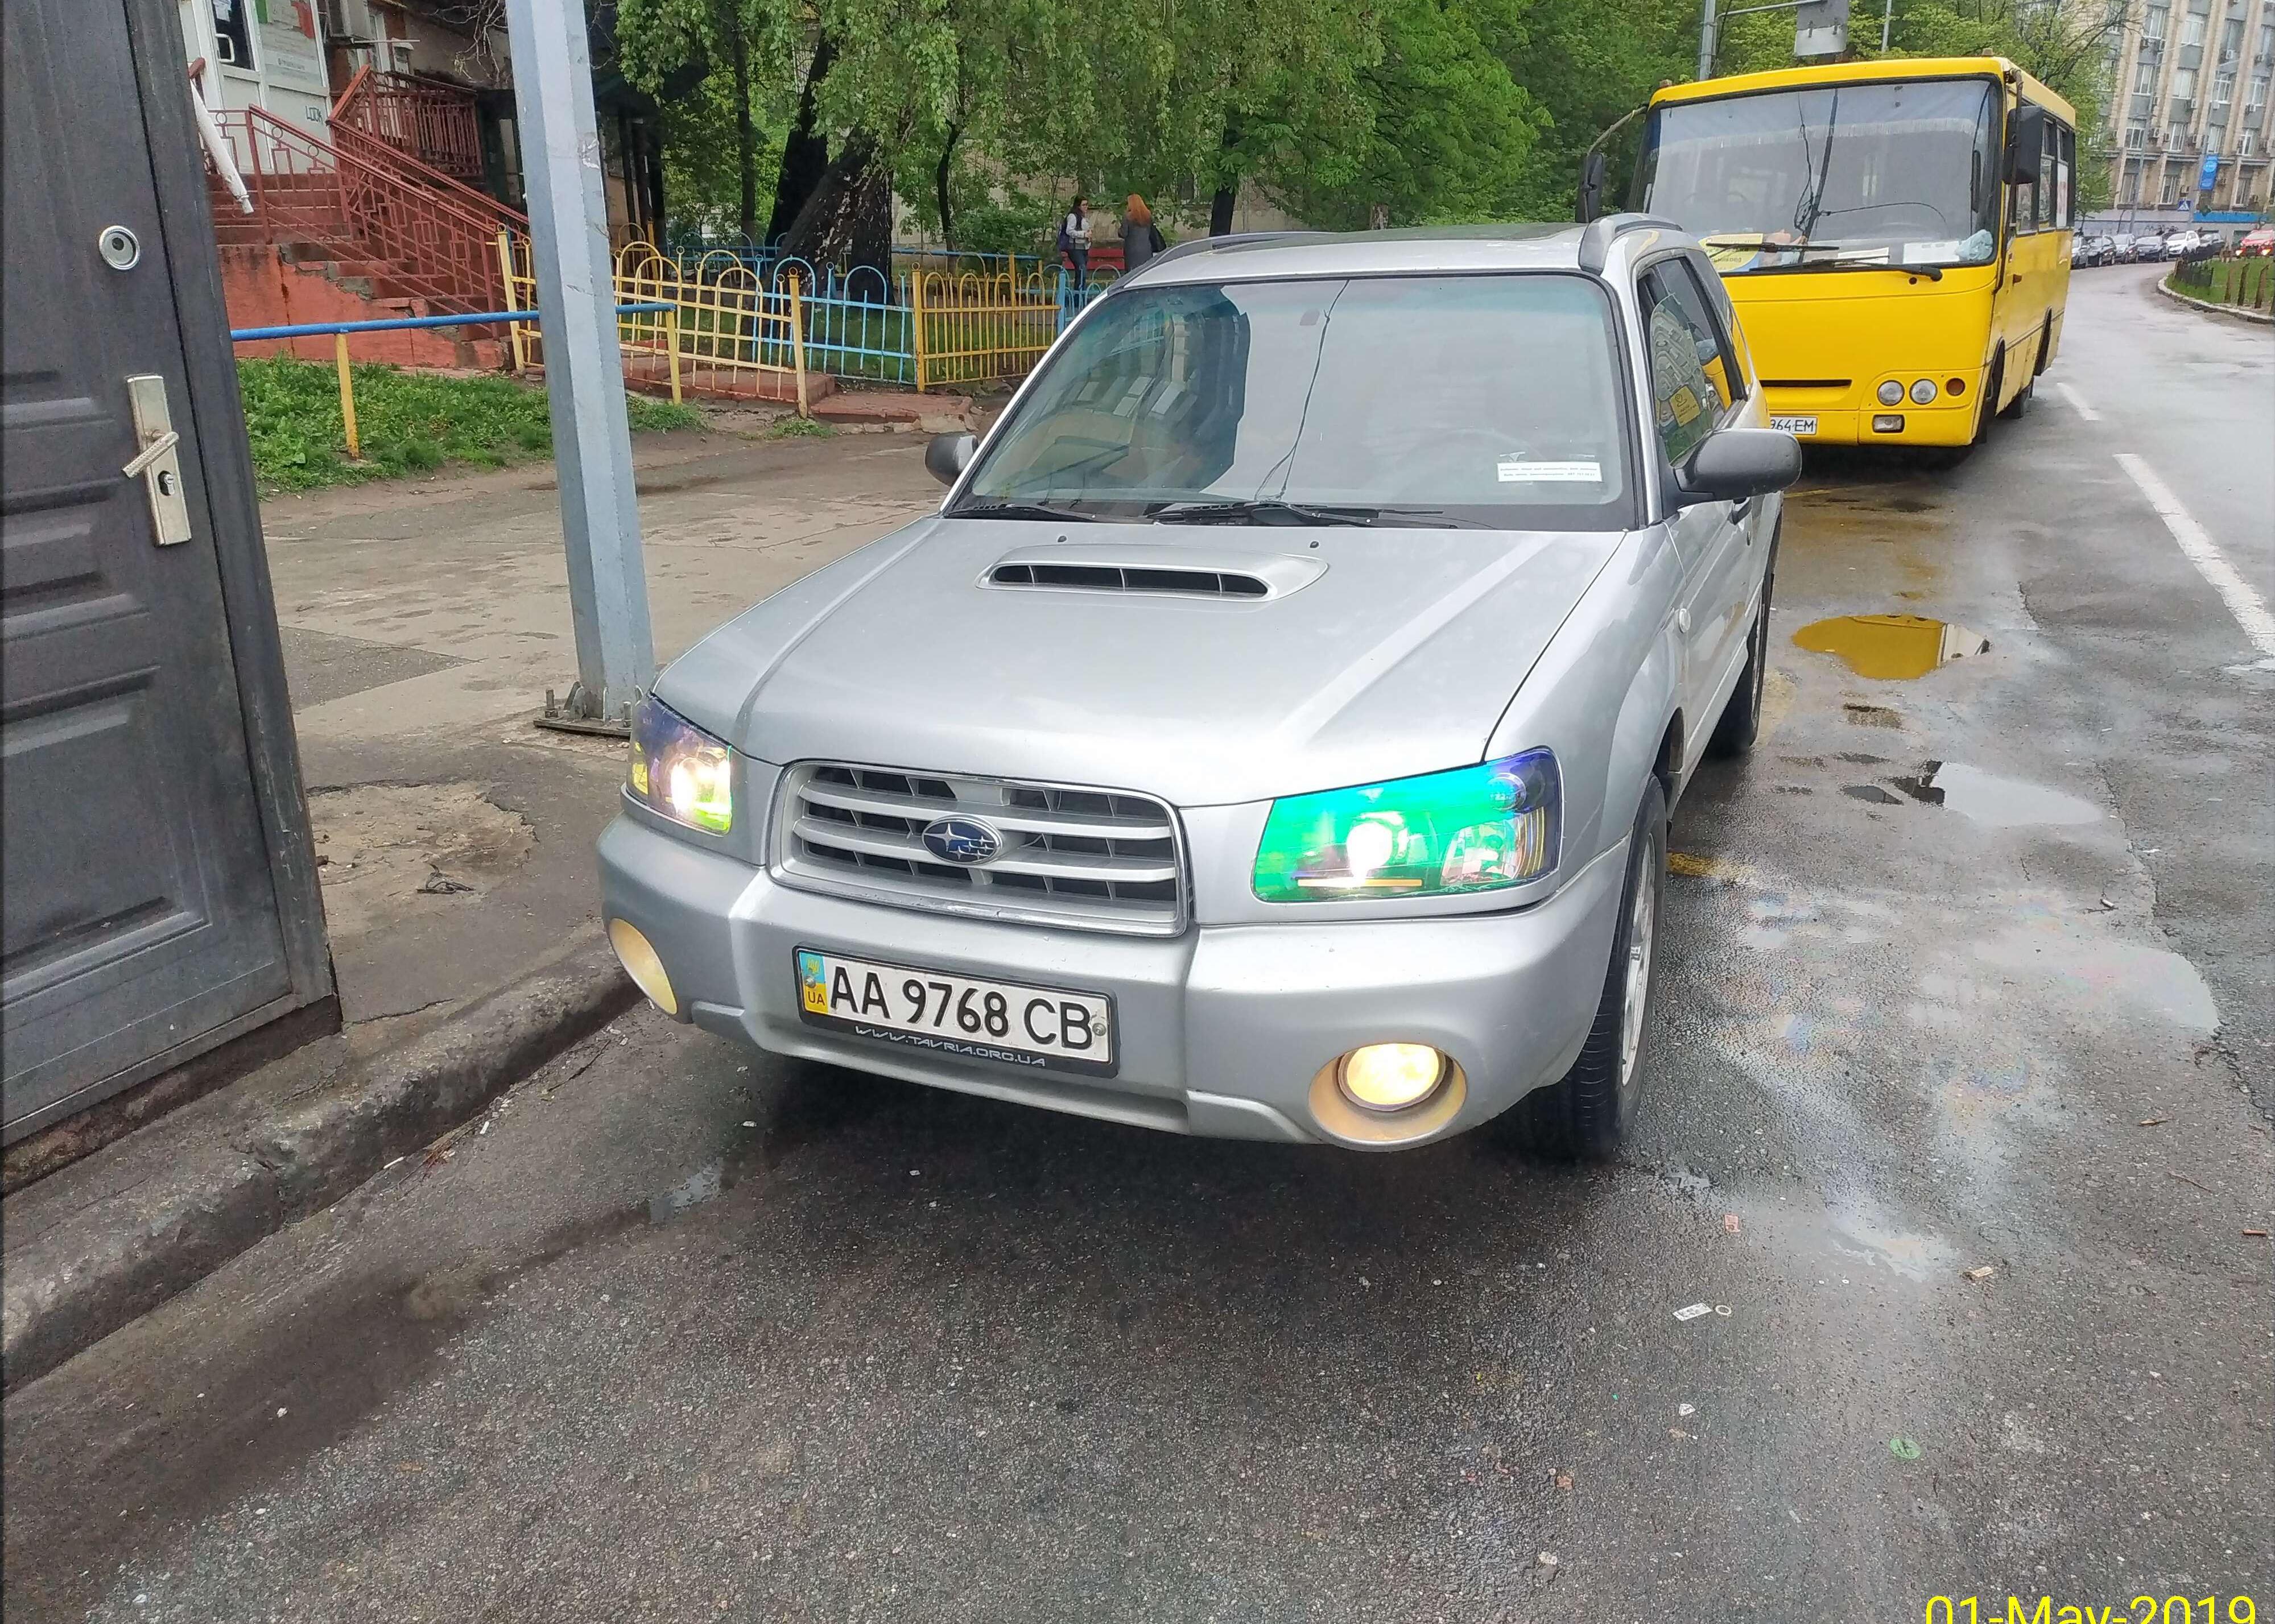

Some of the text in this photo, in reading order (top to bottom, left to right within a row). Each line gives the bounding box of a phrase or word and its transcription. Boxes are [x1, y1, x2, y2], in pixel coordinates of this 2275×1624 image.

[1794, 419, 1814, 432] EM
[808, 991, 825, 1006] UA
[831, 966, 1092, 1049] AA 9768 CB
